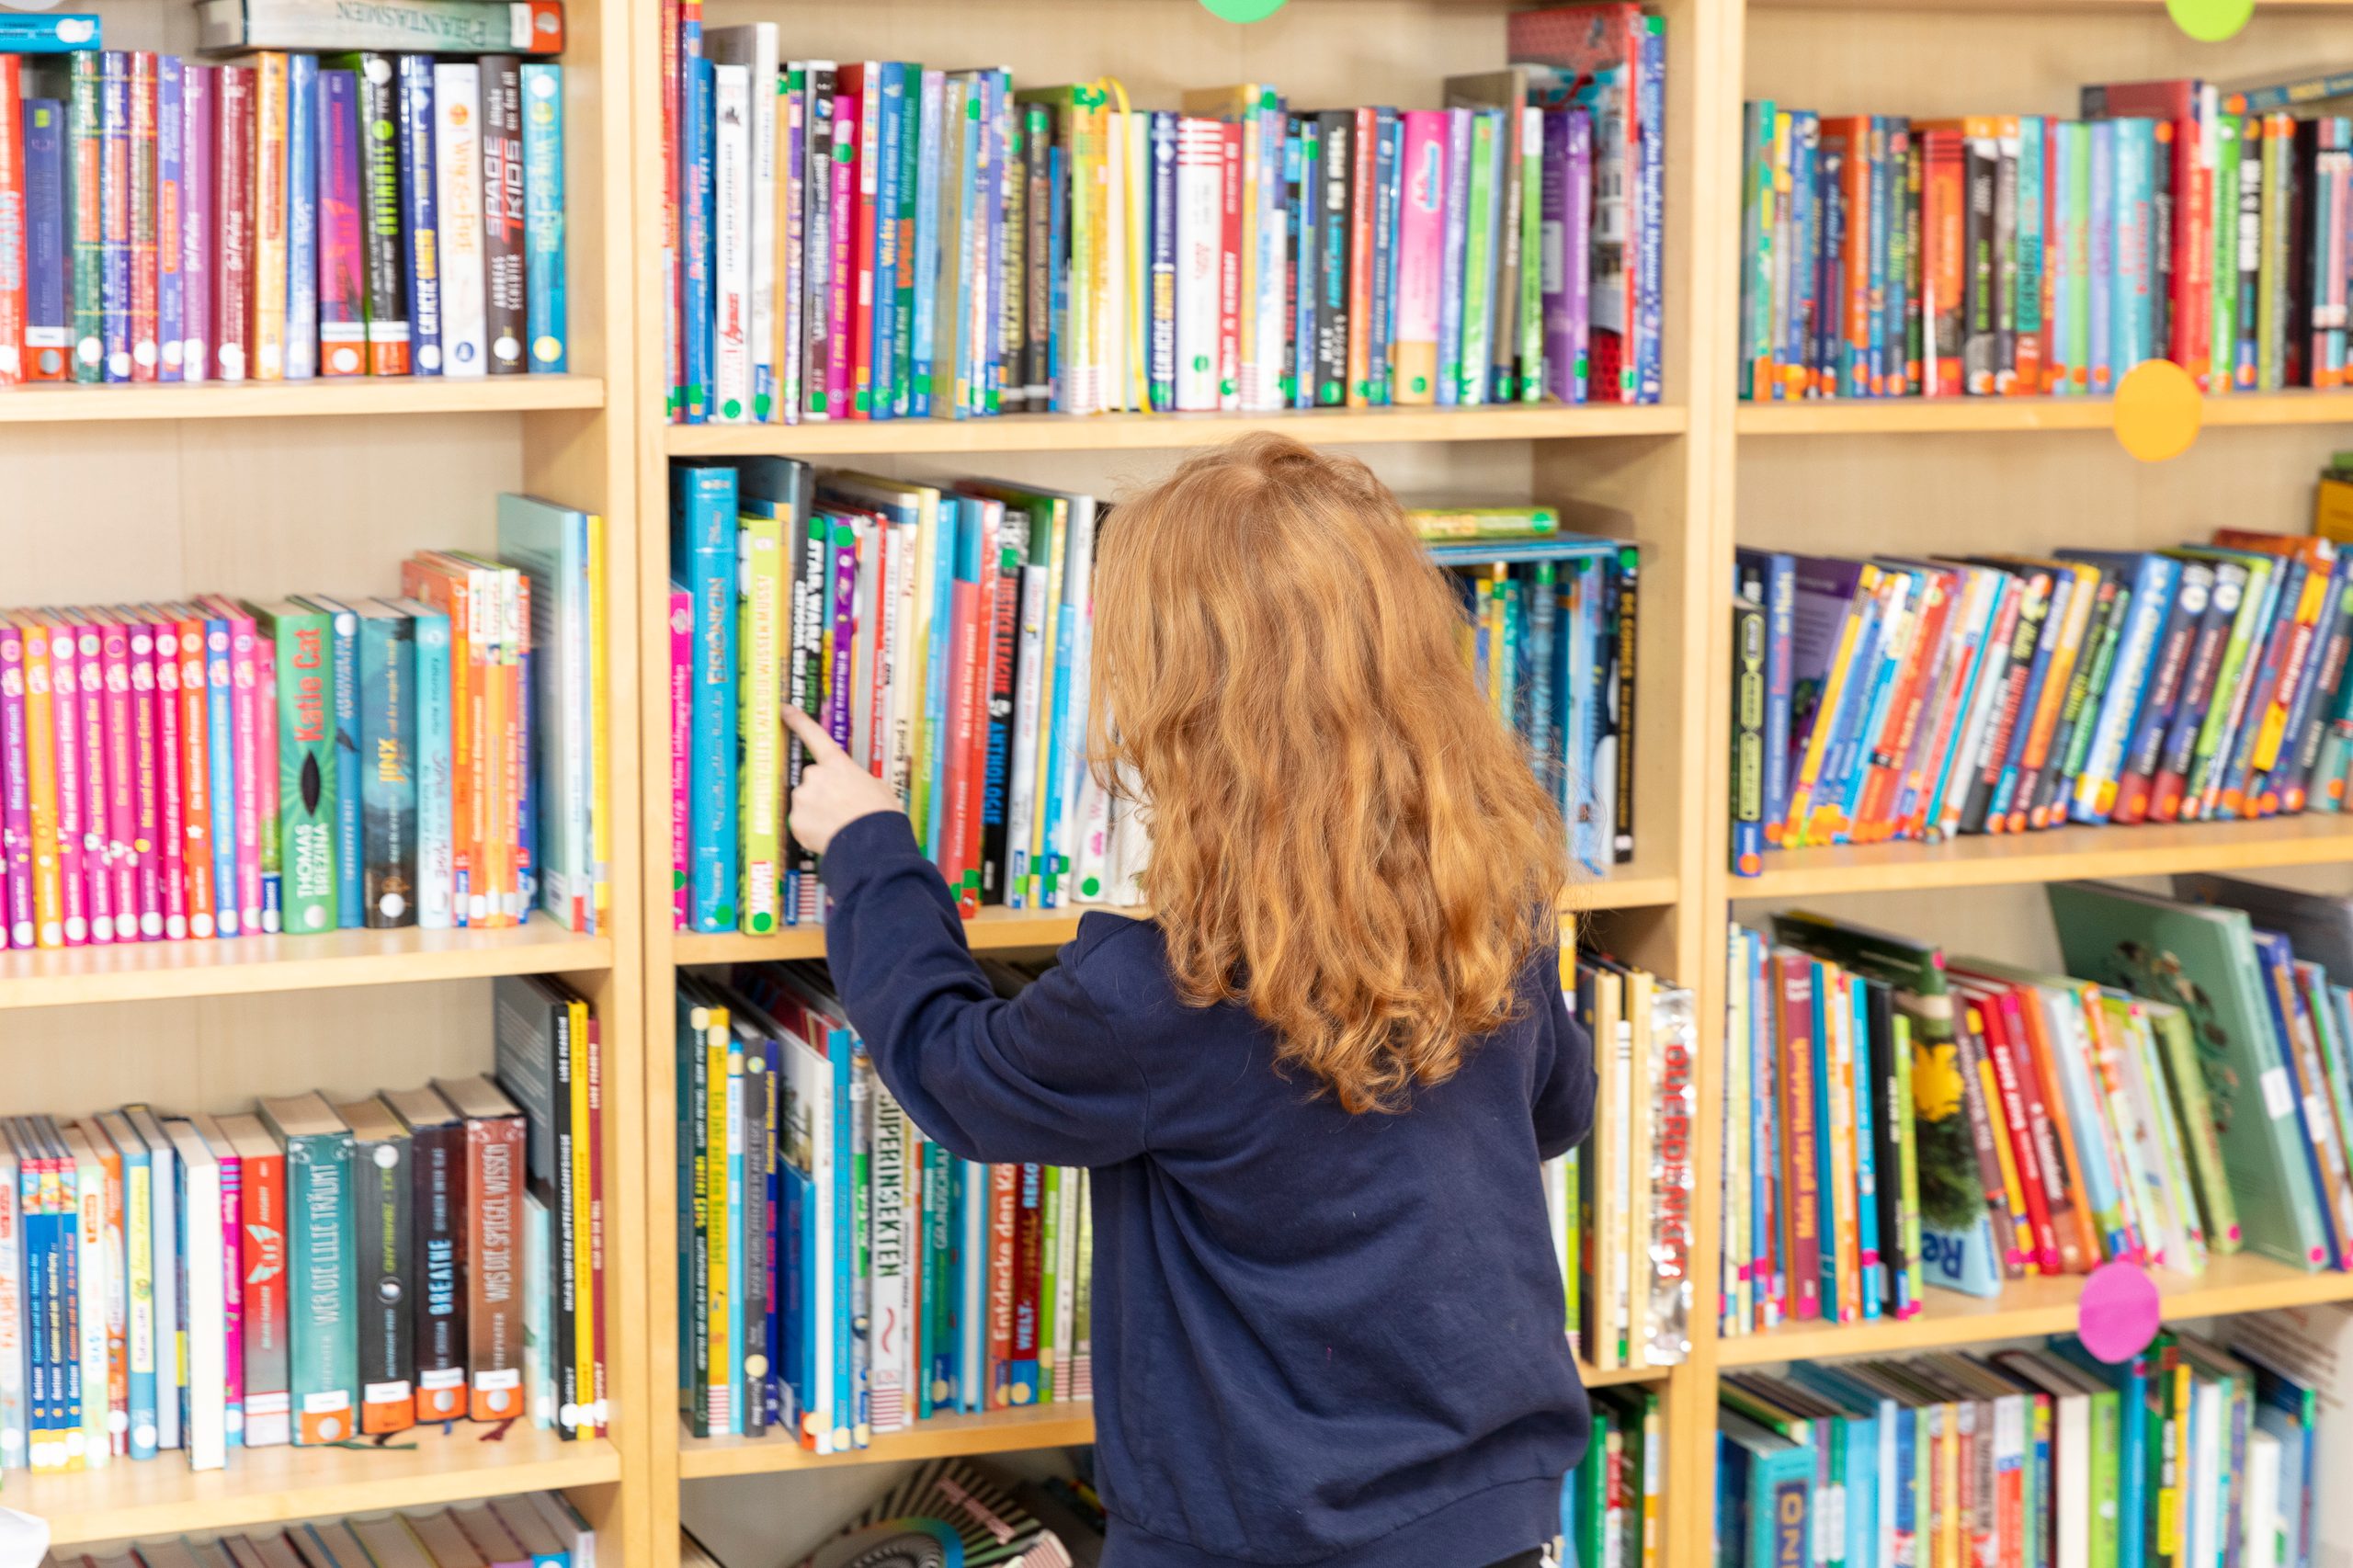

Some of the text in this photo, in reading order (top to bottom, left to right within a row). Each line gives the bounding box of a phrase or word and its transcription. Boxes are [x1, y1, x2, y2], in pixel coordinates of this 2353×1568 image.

[335, 2, 486, 48] PHANTASMEN
[484, 136, 501, 237] SPACE
[506, 139, 523, 221] KIDS
[1326, 181, 1345, 210] DIE
[492, 257, 506, 307] ANDREAS
[1319, 327, 1333, 362] MAX
[1332, 314, 1346, 378] BROOKS
[755, 574, 771, 621] MUSST
[804, 539, 822, 653] STAR WARS
[705, 577, 728, 685] EISKÖNIGIN
[756, 624, 771, 676] WISSEN
[992, 577, 1017, 695] JUSTICE LEAGUE
[293, 628, 324, 742] Katie Cat
[755, 699, 772, 730] WAS
[87, 722, 101, 748] Baby
[378, 738, 406, 784] JINX
[981, 722, 1007, 824] ANTHOLOGIE
[294, 824, 313, 898] THOMAS
[313, 823, 331, 896] BREZINA
[751, 860, 773, 915] MARVEL
[557, 1017, 569, 1083] LUKE PEARSON
[588, 1043, 599, 1109] LUKE PEARSON
[710, 1091, 724, 1112] Ein
[482, 1143, 509, 1195] WISSEN
[1659, 1043, 1689, 1279] QUERDENKER
[1790, 1037, 1816, 1239] Mein großes Hundebuch
[710, 1170, 724, 1196] dem
[876, 1092, 904, 1278] SUPERINSEKTEN
[306, 1164, 339, 1325] WER DIE LILIE TRÄUMT
[483, 1196, 511, 1246] SPIEGEL
[709, 1199, 725, 1266] Bauernhof
[994, 1196, 1014, 1237] den
[427, 1239, 453, 1315] BREATHE
[483, 1248, 511, 1269] DIE
[994, 1243, 1013, 1342] Entdecke
[1017, 1301, 1035, 1349] WELT-
